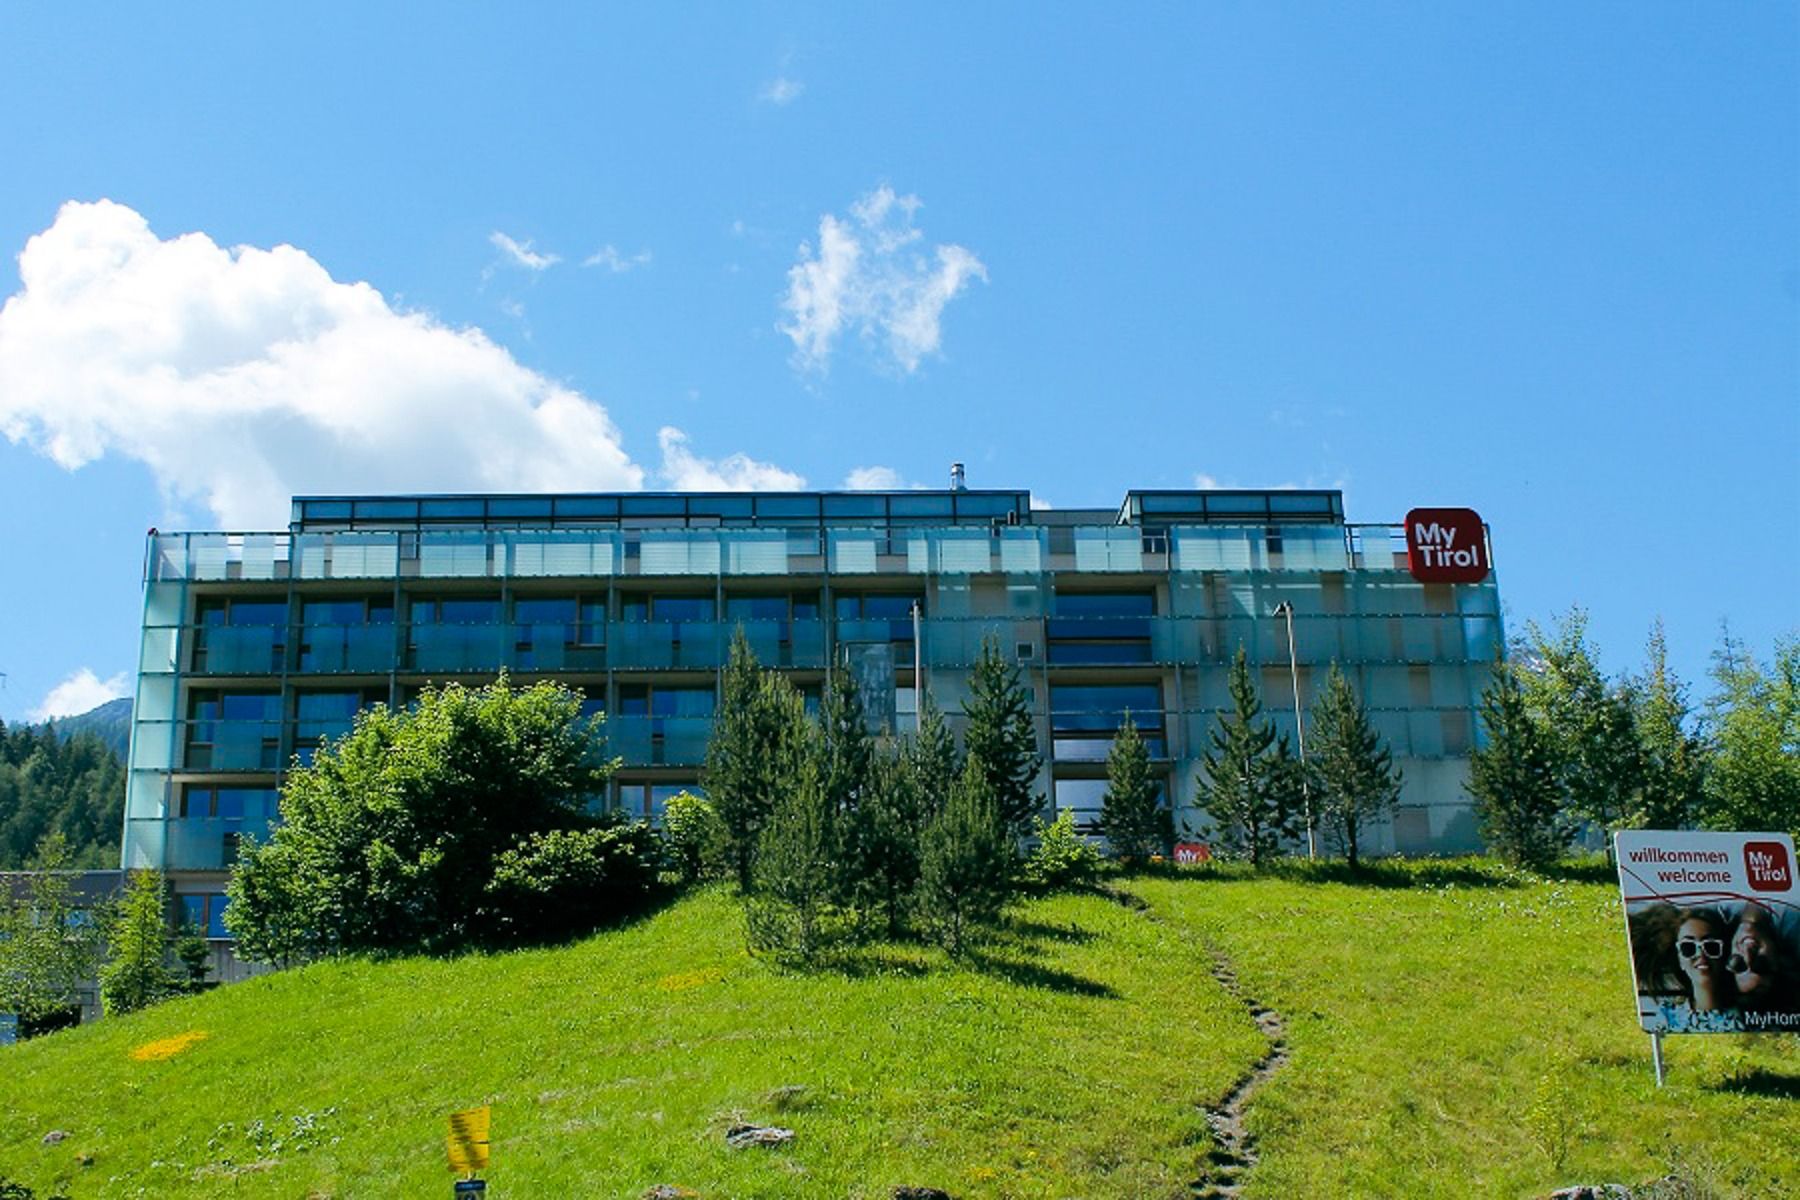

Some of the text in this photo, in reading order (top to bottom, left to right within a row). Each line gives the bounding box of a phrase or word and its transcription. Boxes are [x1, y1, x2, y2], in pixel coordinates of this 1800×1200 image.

[1415, 522, 1457, 549] My
[1417, 544, 1479, 568] Tirol
[1629, 847, 1729, 864] willkommen
[1748, 851, 1773, 869] My
[1657, 867, 1731, 883] welcome
[1751, 866, 1787, 881] Tirol
